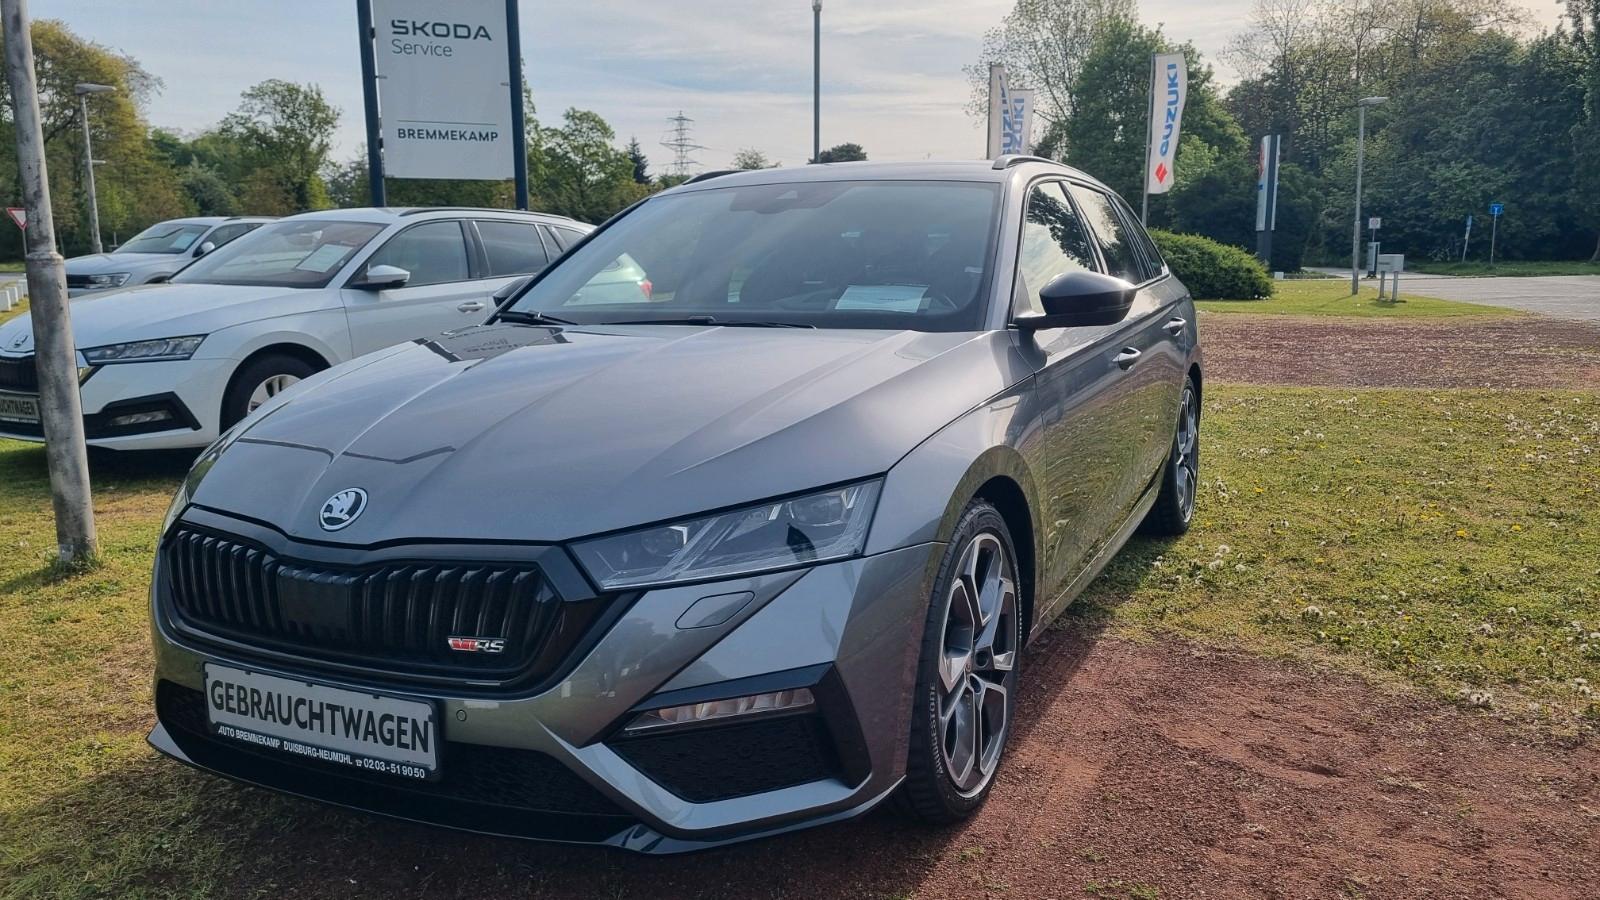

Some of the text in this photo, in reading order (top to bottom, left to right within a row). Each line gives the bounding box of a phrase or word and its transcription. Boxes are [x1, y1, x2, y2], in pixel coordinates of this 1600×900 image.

[391, 38, 453, 57] Service
[397, 128, 498, 142] BREMMEKAMP
[210, 680, 429, 753] GEBRAUCHTWAGEN
[218, 725, 235, 738] AUTO
[235, 729, 281, 749] BREMMEKAMP
